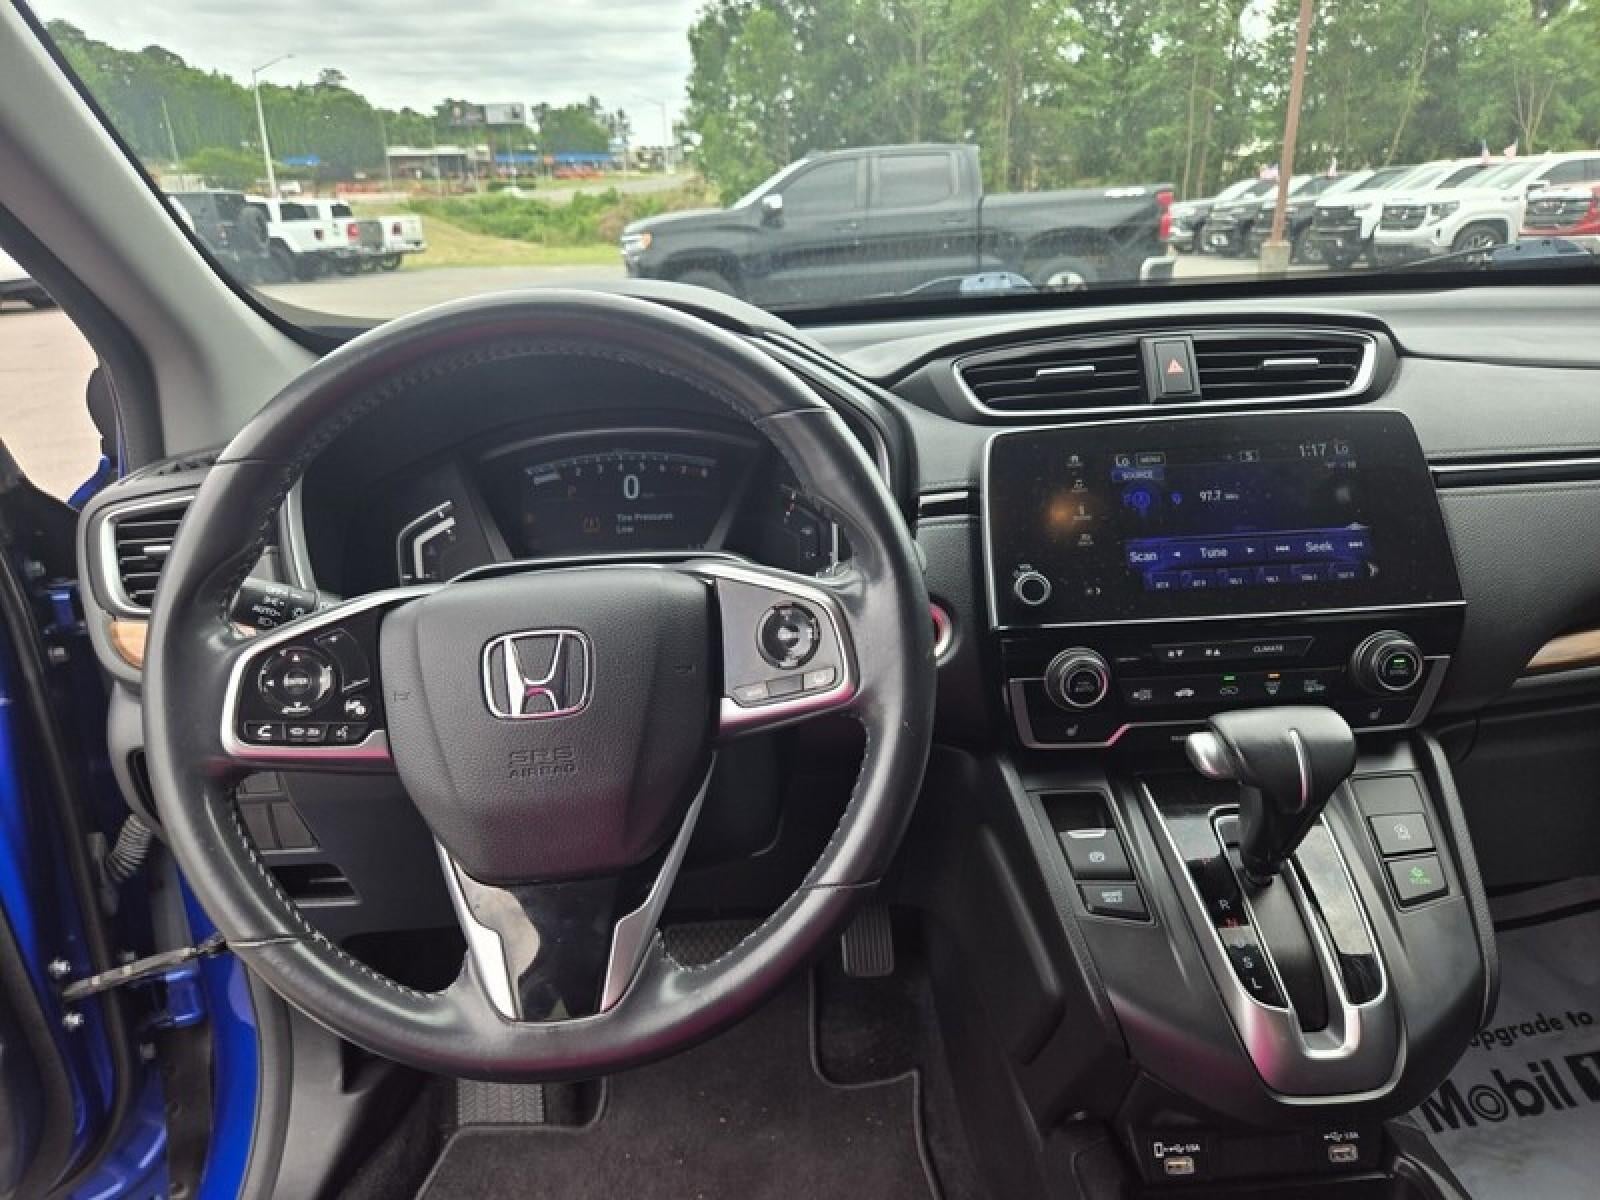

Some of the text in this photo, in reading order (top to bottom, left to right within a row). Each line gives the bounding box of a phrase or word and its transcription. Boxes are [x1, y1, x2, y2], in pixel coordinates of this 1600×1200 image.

[1299, 443, 1327, 457] 1:17
[623, 474, 640, 500] 0
[1199, 547, 1228, 559] Tune
[1305, 541, 1334, 553] Seek
[1129, 551, 1158, 563] Scan
[1566, 1011, 1593, 1028] to
[1419, 1059, 1580, 1133] Mobil
